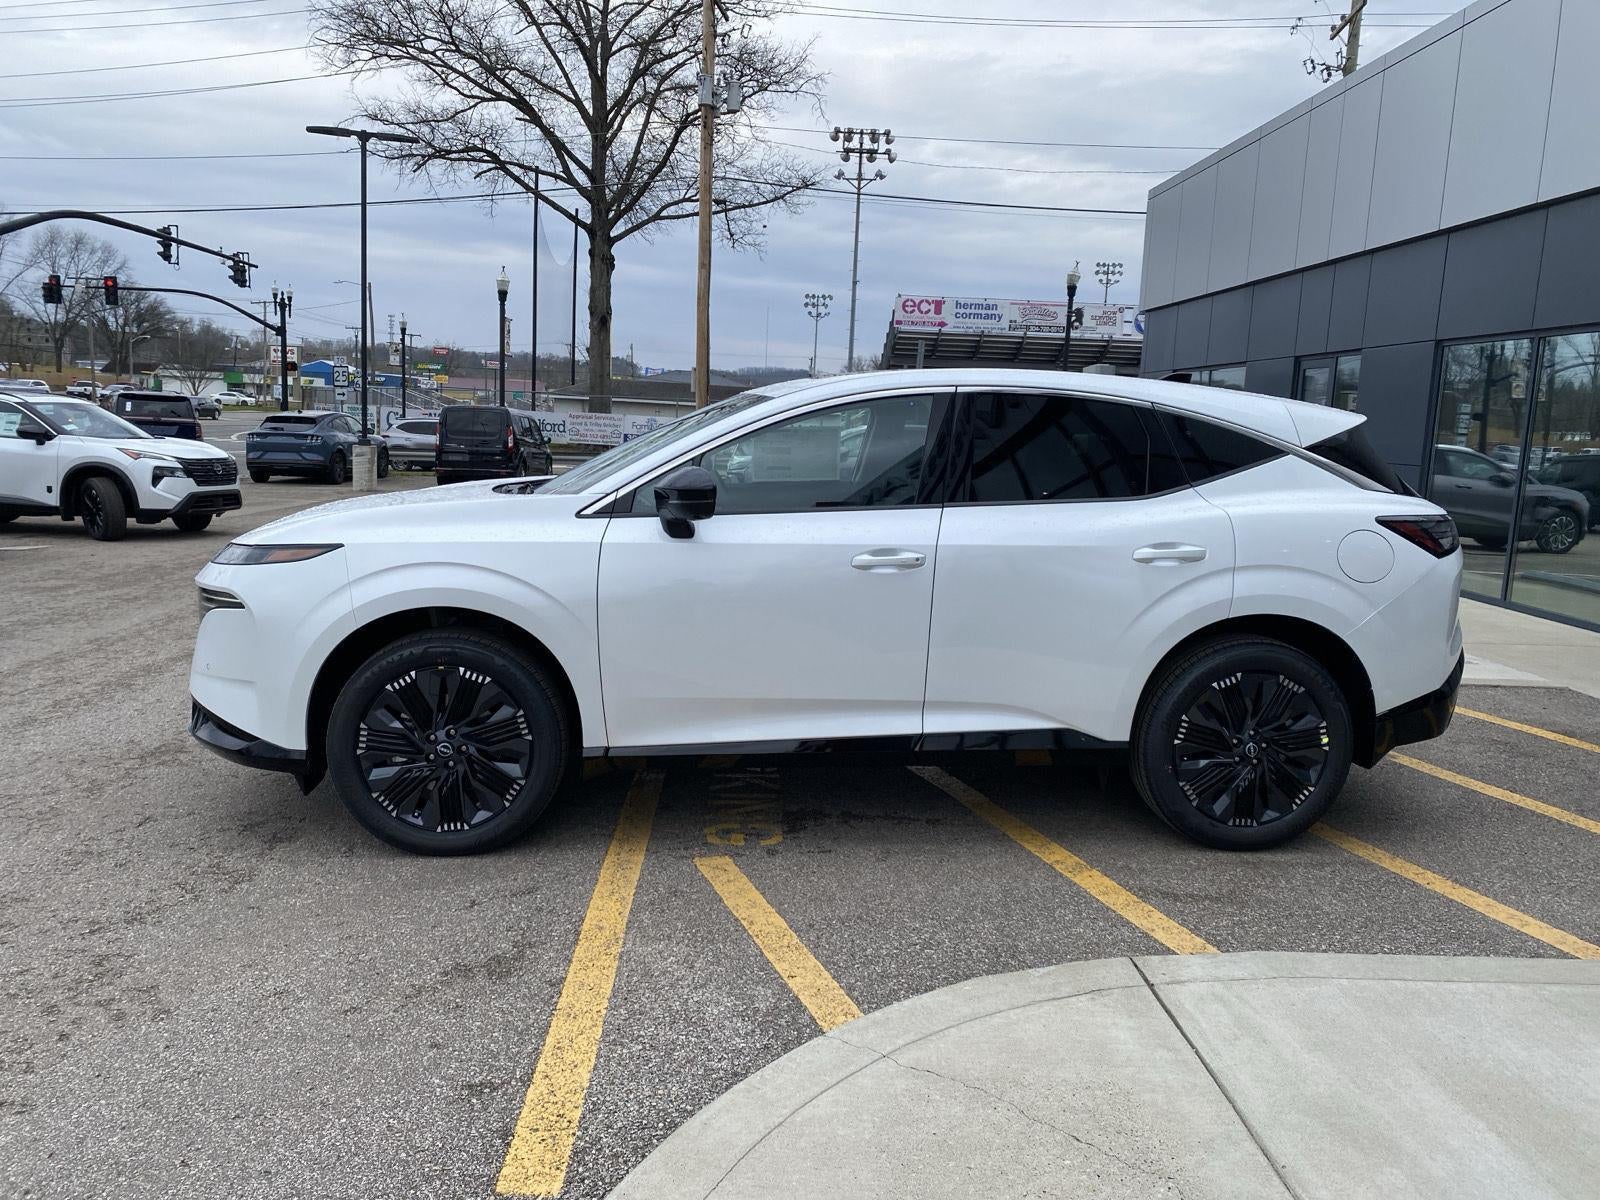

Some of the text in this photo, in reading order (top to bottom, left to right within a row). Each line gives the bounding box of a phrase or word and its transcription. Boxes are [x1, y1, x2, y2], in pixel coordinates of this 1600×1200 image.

[955, 301, 998, 311] herman
[954, 311, 1004, 322] cormany
[334, 370, 348, 383] 25
[569, 412, 593, 420] Appraisal
